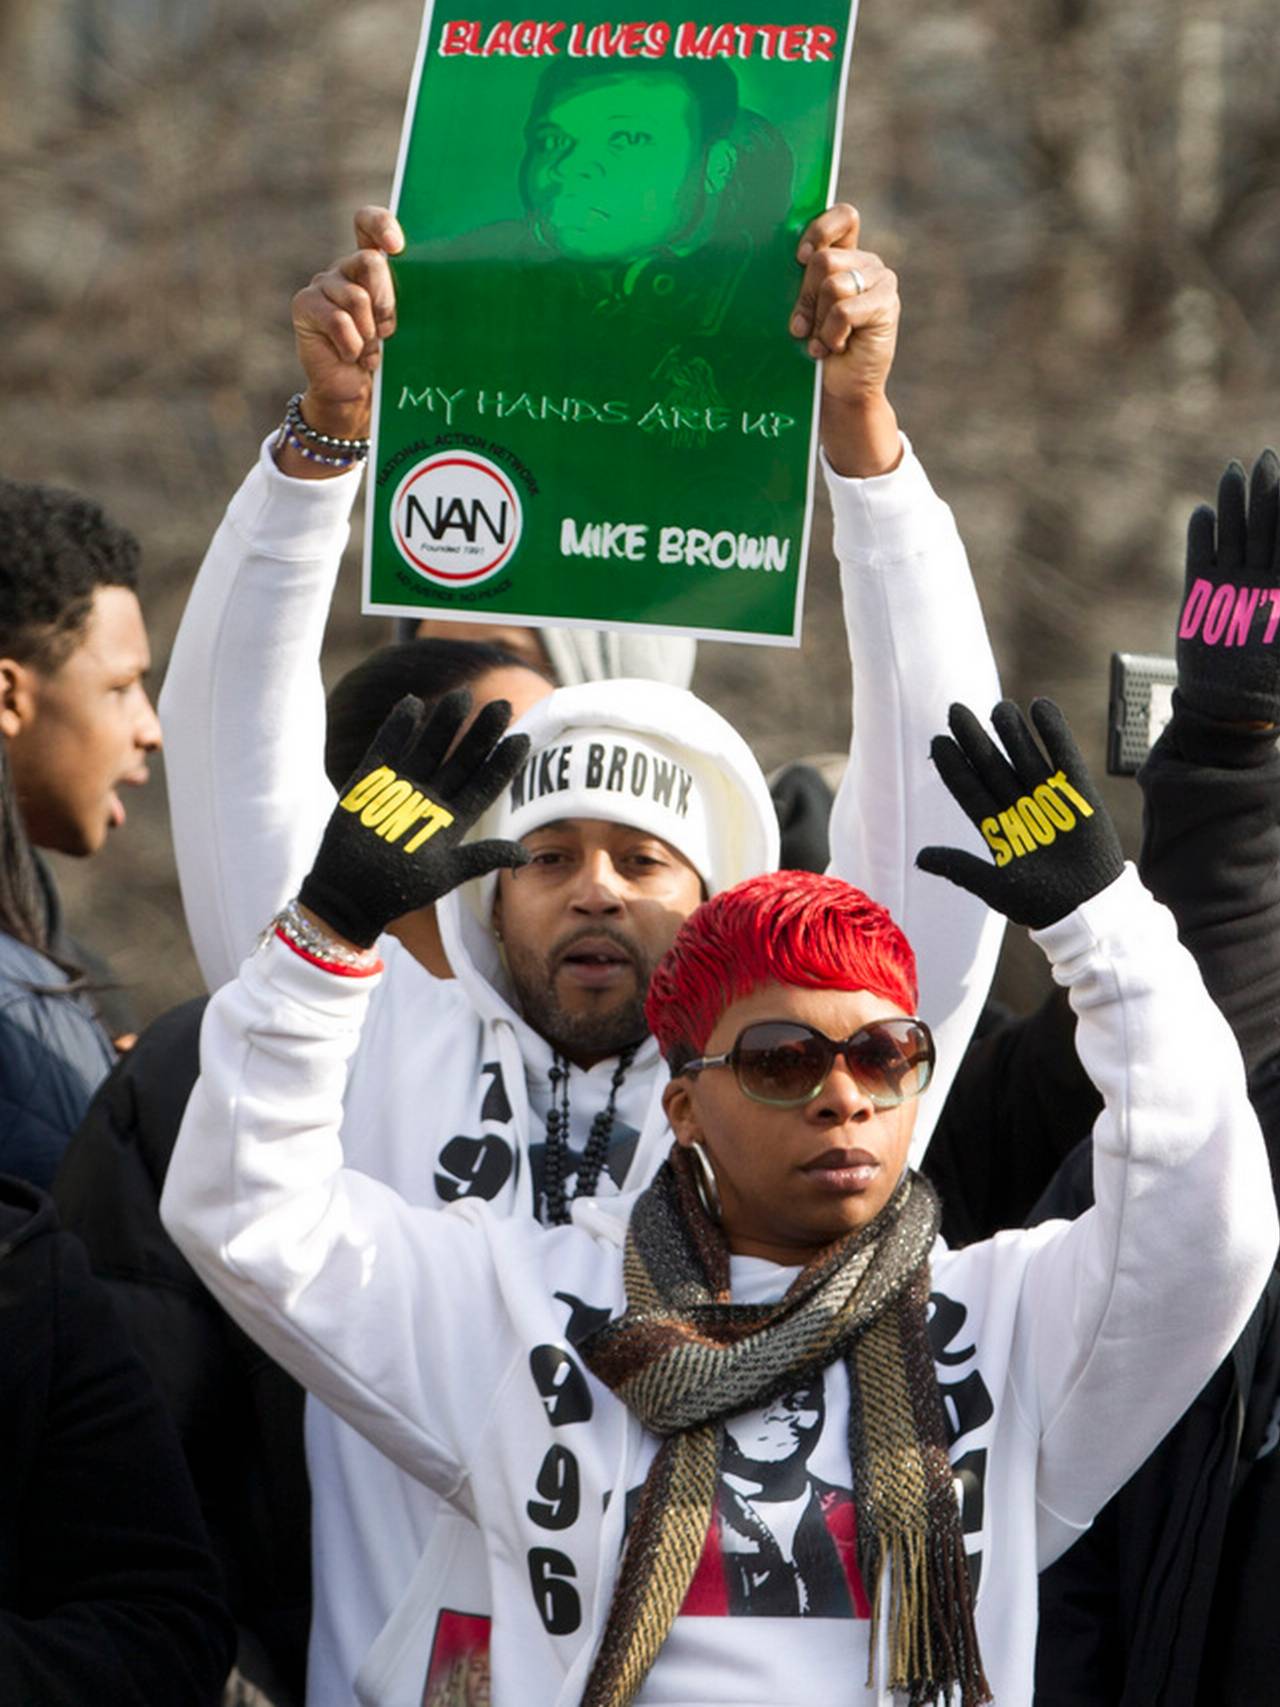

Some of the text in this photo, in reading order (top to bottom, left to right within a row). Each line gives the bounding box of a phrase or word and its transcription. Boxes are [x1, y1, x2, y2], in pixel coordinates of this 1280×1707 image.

[440, 20, 837, 62] BLACK LIVES MATTER
[398, 386, 795, 437] MY HANDS ARE UP
[376, 432, 539, 497] NATIONAL ACTION NETWORK
[405, 494, 507, 544] NAN
[560, 518, 791, 572] MIKE BROWN
[511, 743, 692, 819] MIKE BROWN
[980, 770, 1095, 867] SHOOT
